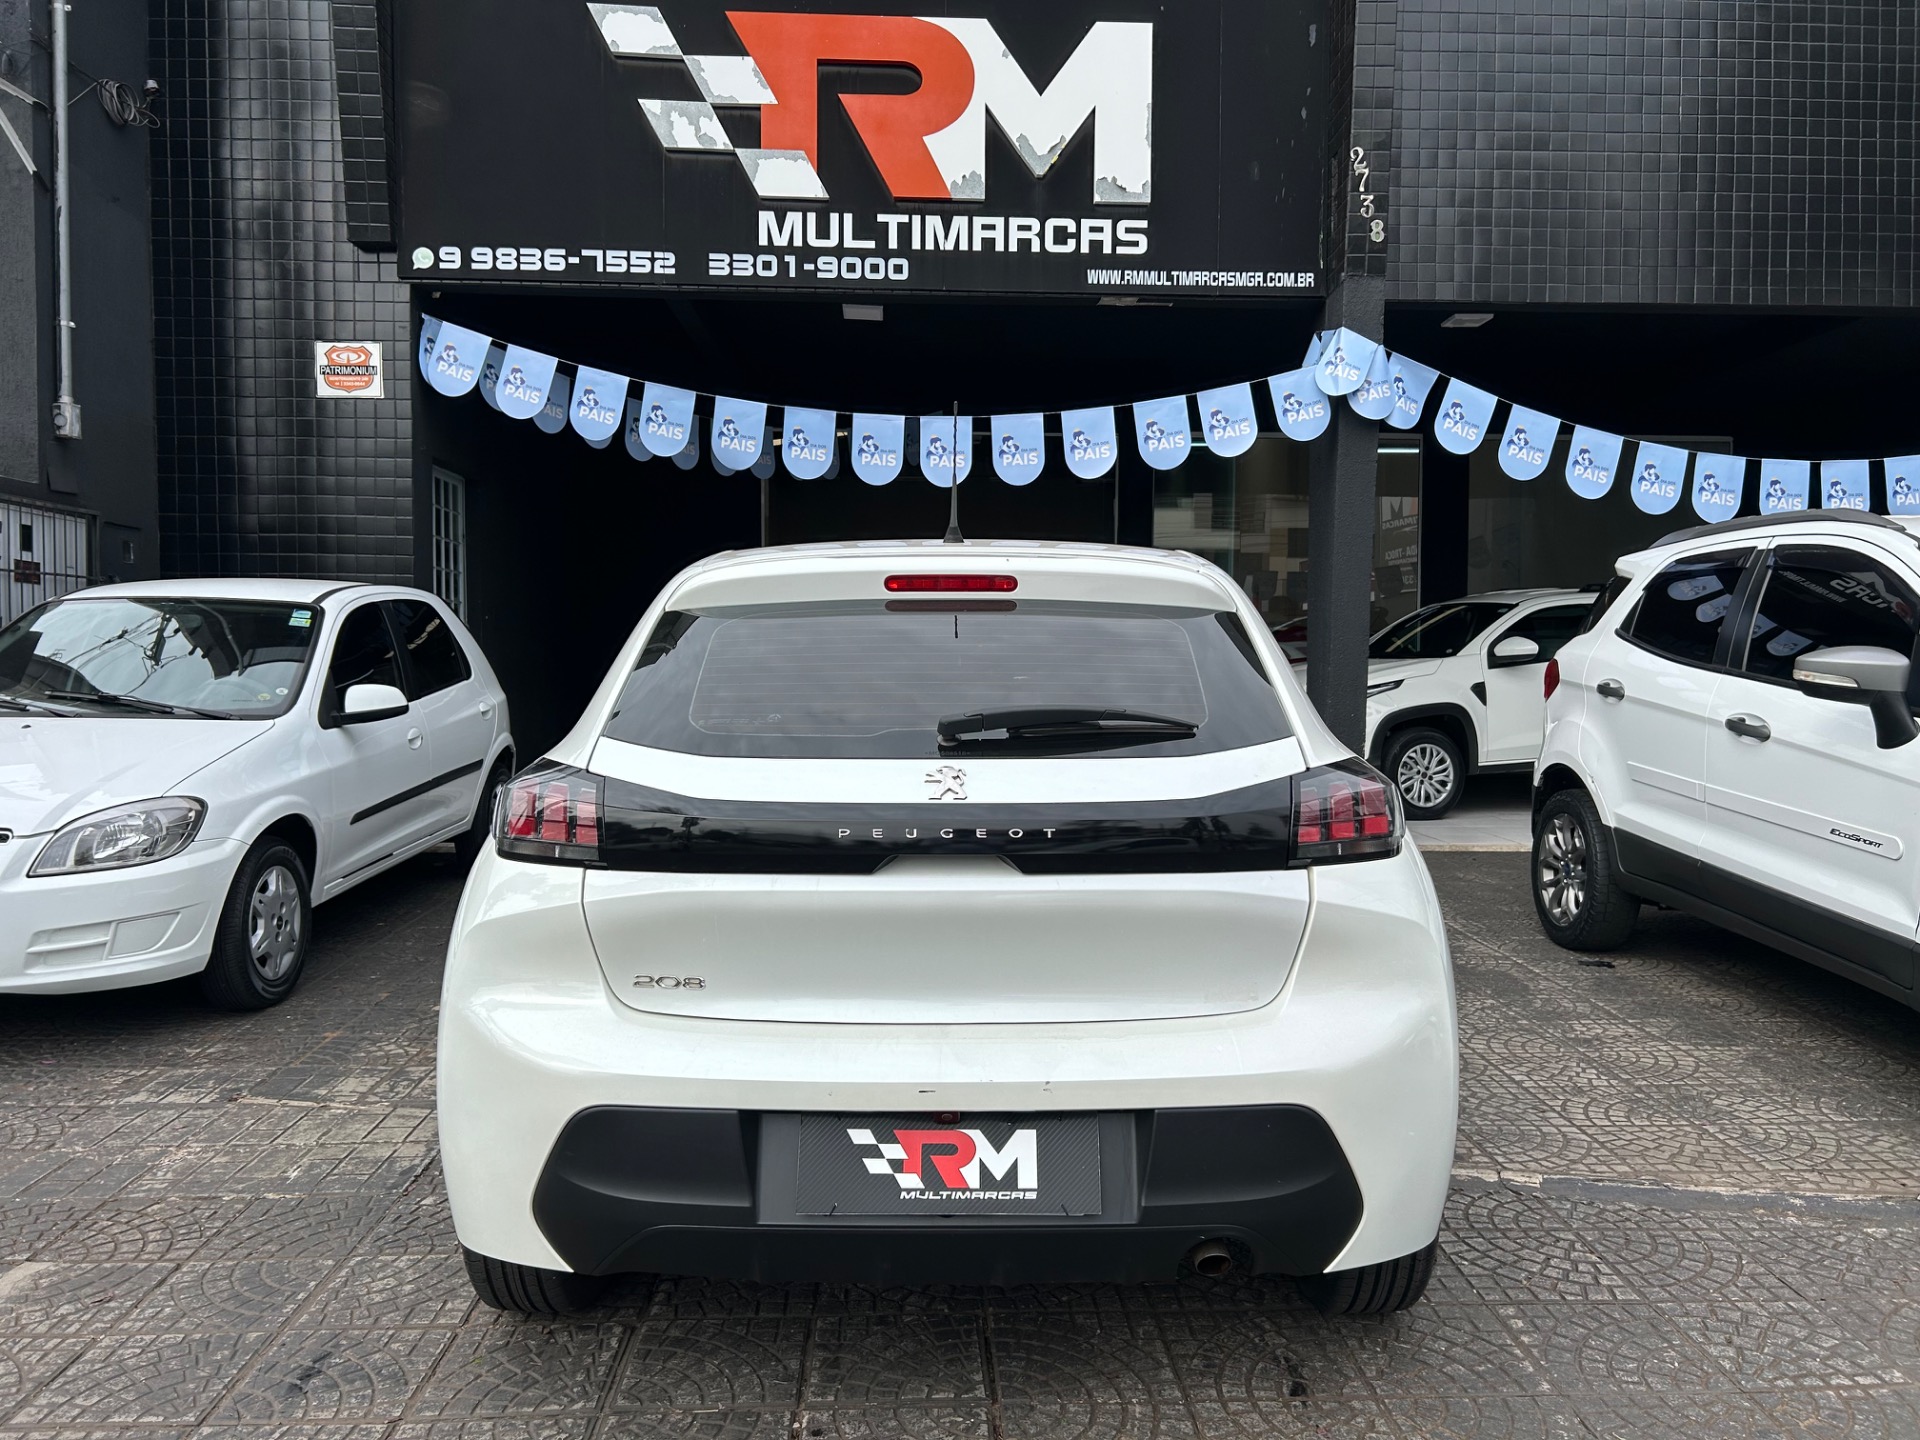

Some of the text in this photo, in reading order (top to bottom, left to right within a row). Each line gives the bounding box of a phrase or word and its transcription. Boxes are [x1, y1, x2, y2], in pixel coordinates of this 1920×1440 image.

[725, 11, 1153, 204] RM
[1350, 146, 1385, 242] 2738
[758, 210, 1149, 255] MULTIMARCAS
[438, 246, 677, 276] 9 9836-7552
[708, 252, 909, 281] 3301-9000
[1087, 268, 1315, 288] WWW.RMMULTIMARCASMGA.COM.BR
[320, 365, 377, 375] PATRIMONIUM
[437, 361, 473, 382] PAIS
[1325, 364, 1360, 381] PAIS
[505, 385, 541, 404] PAIS
[1357, 384, 1391, 403] PAIS
[544, 405, 563, 419] AIS
[578, 405, 615, 425] PAIS
[1287, 404, 1324, 425] PAIS
[648, 422, 683, 440] PAIS
[1214, 421, 1250, 440] PAIS
[1443, 417, 1477, 440] PAIS
[683, 443, 695, 455] AIS
[721, 436, 756, 453] PAIS
[1148, 434, 1185, 452] PAIS
[758, 455, 772, 465] AIS
[791, 446, 827, 461] PAIS
[861, 452, 897, 467] PAIS
[1002, 451, 1038, 466] PAIS
[1075, 445, 1110, 461] PAIS
[1508, 444, 1543, 465] PAIS
[1574, 464, 1608, 484] PAIS
[1640, 480, 1675, 498] PAIS
[1701, 490, 1735, 506] PAIS
[1769, 497, 1802, 510] PAIS
[1831, 497, 1864, 510] PAIS
[1896, 493, 1920, 506] PAI
[838, 828, 1056, 838] PEUGEOT
[632, 973, 706, 991] 208
[893, 1129, 1038, 1189] RM
[900, 1191, 1038, 1200] MULTIMARCAS
